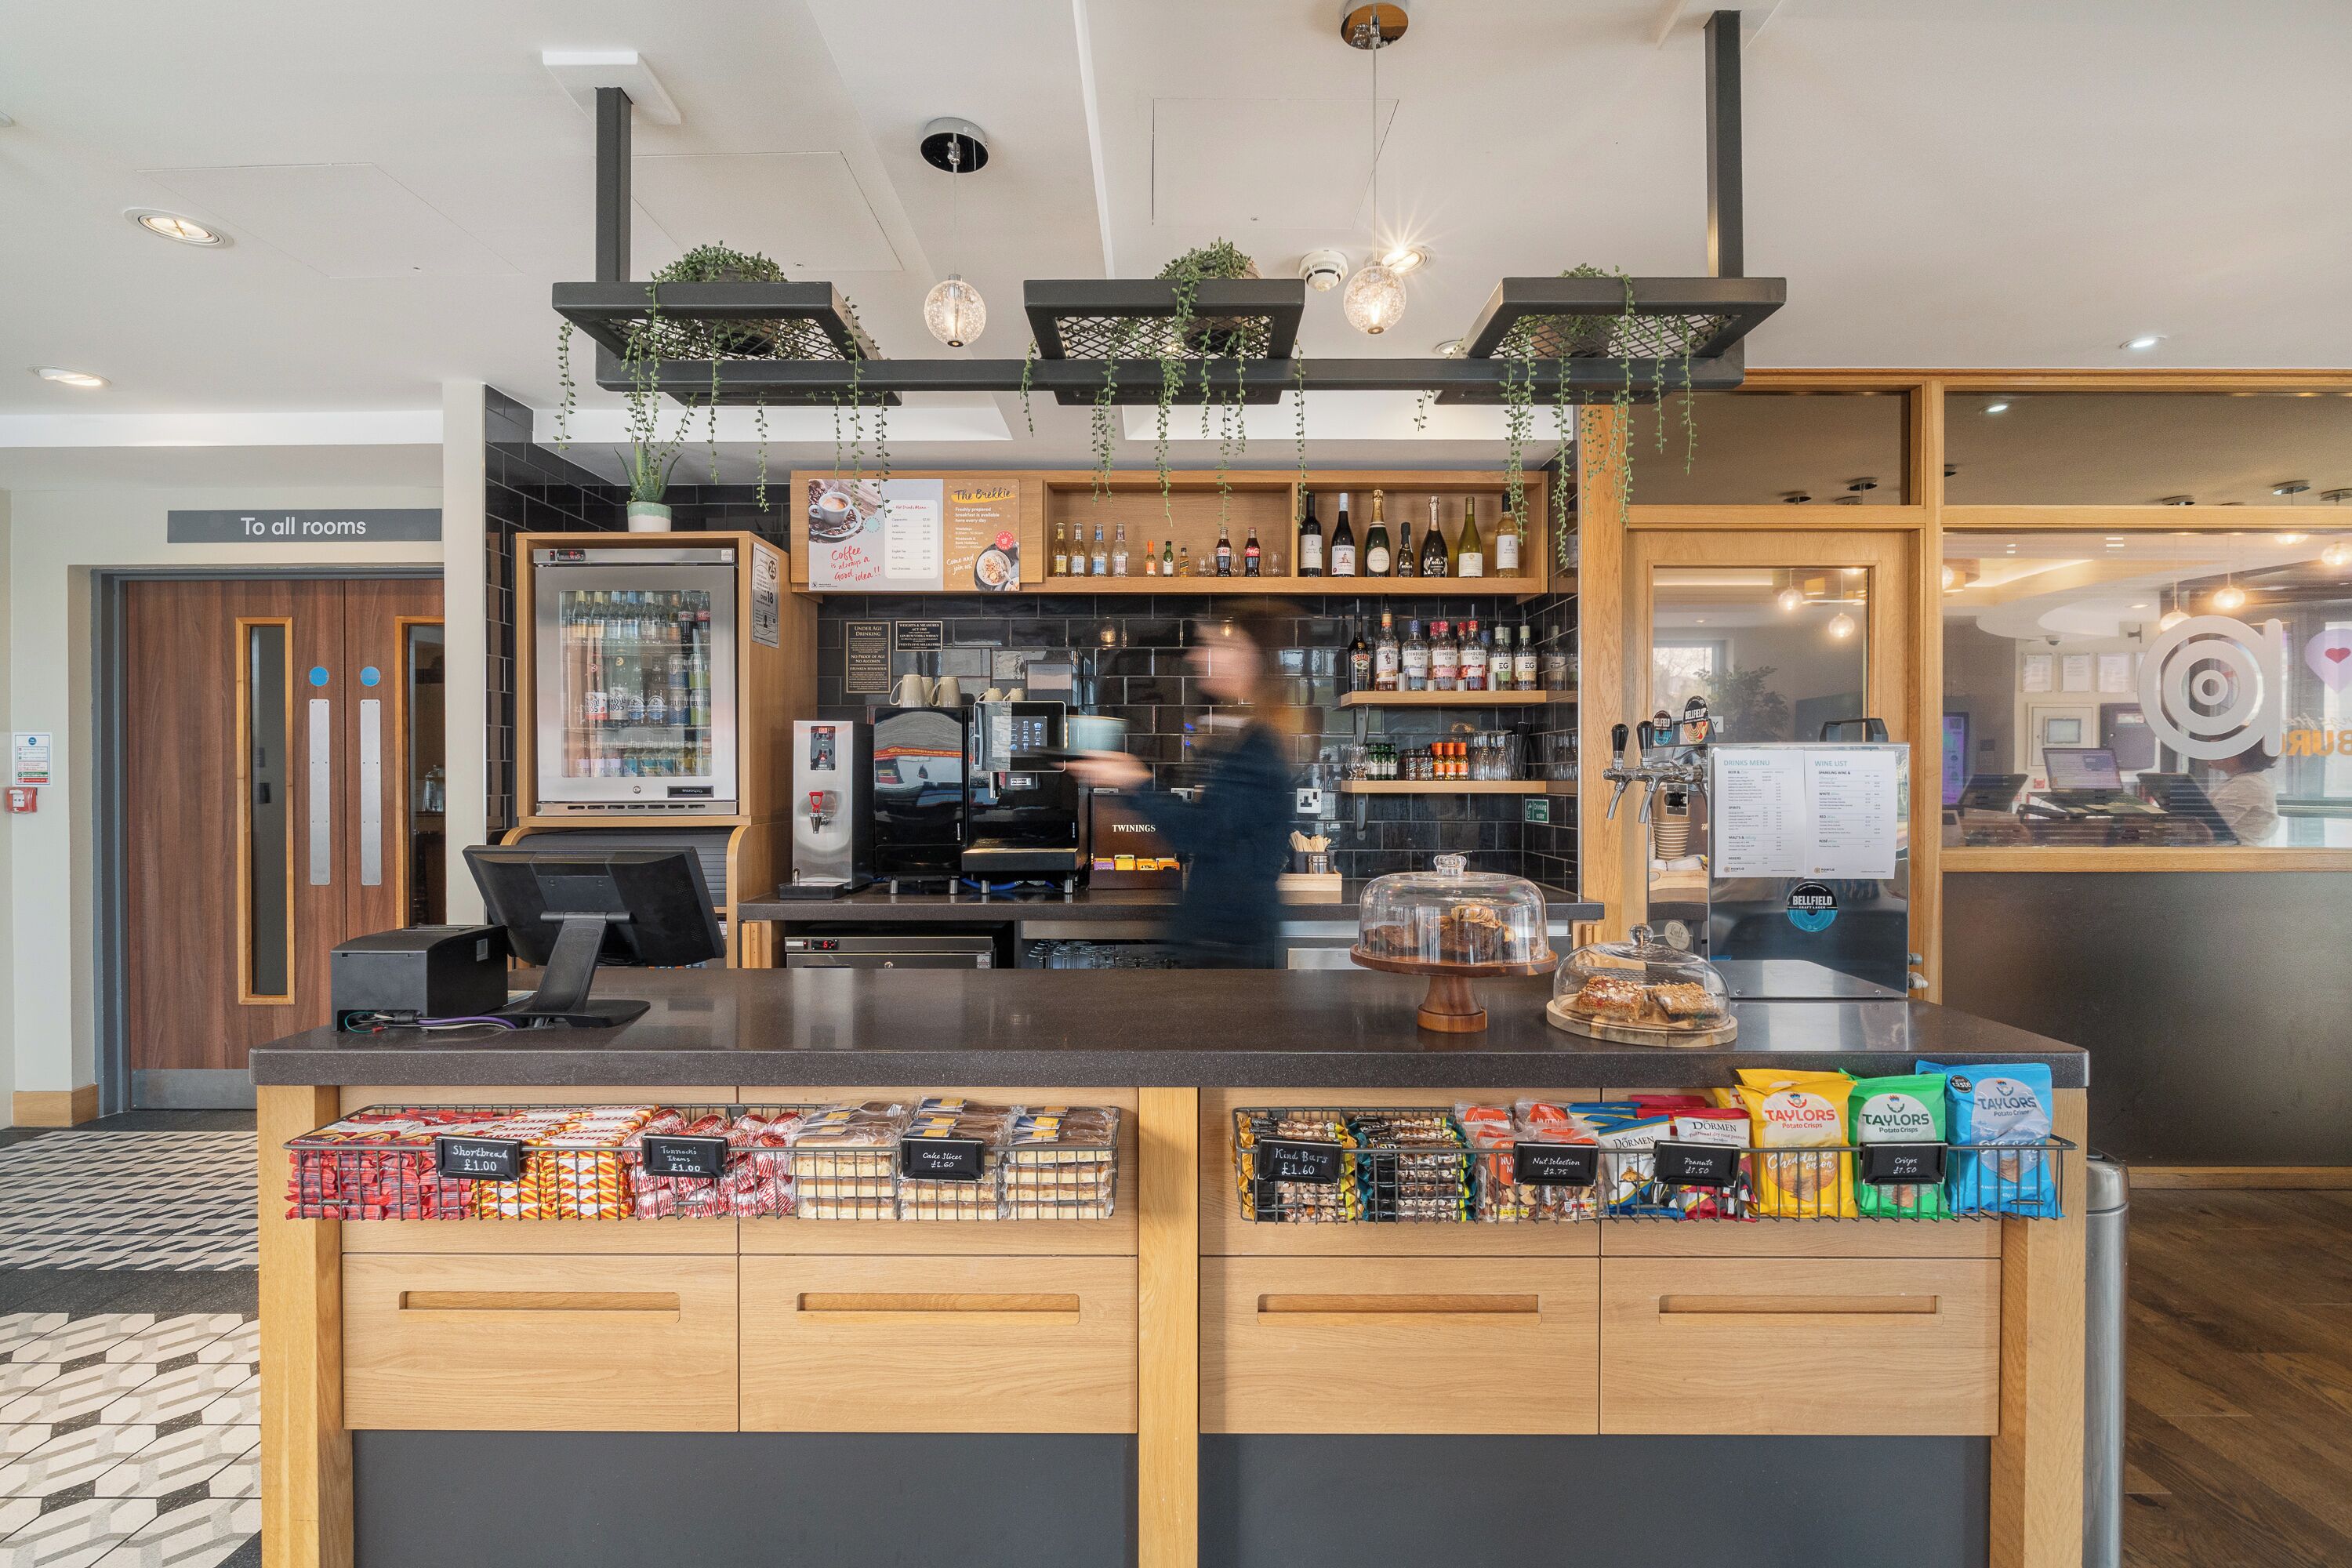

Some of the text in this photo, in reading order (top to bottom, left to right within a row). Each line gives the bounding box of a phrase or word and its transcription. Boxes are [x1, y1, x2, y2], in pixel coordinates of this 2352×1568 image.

[954, 487, 1011, 501] The Brekkie
[240, 516, 366, 535] To all rooms
[831, 545, 862, 561] Coffee
[838, 559, 862, 570] always
[946, 554, 975, 566] Come and
[768, 562, 776, 579] 25
[953, 564, 964, 575] join
[768, 591, 774, 604] 18
[1653, 717, 1670, 728] BELLFIELD
[1534, 803, 1547, 813] Drinking
[1112, 824, 1156, 833] TWININGS
[1792, 895, 1832, 906] BELLFIELD
[1977, 1097, 2038, 1109] TAYLORS
[1765, 1109, 1835, 1121] TAYLORS
[1862, 1113, 1929, 1126] TAYLORS
[1693, 1121, 1737, 1132] DORMEN
[1613, 1136, 1655, 1149] DORMEN
[452, 1145, 508, 1160] Shortbread
[660, 1145, 697, 1155] Tunnock's
[1275, 1148, 1328, 1163] Kind Bars
[463, 1158, 497, 1171] £1.00
[1548, 1156, 1581, 1166] Selection
[1684, 1157, 1713, 1166] Peanuts
[1806, 1161, 1834, 1170] onon
[1894, 1156, 1918, 1167] Crisps
[670, 1163, 701, 1172] £1.00
[1281, 1162, 1315, 1175] £1.60
[1893, 1166, 1917, 1174] £1.50
